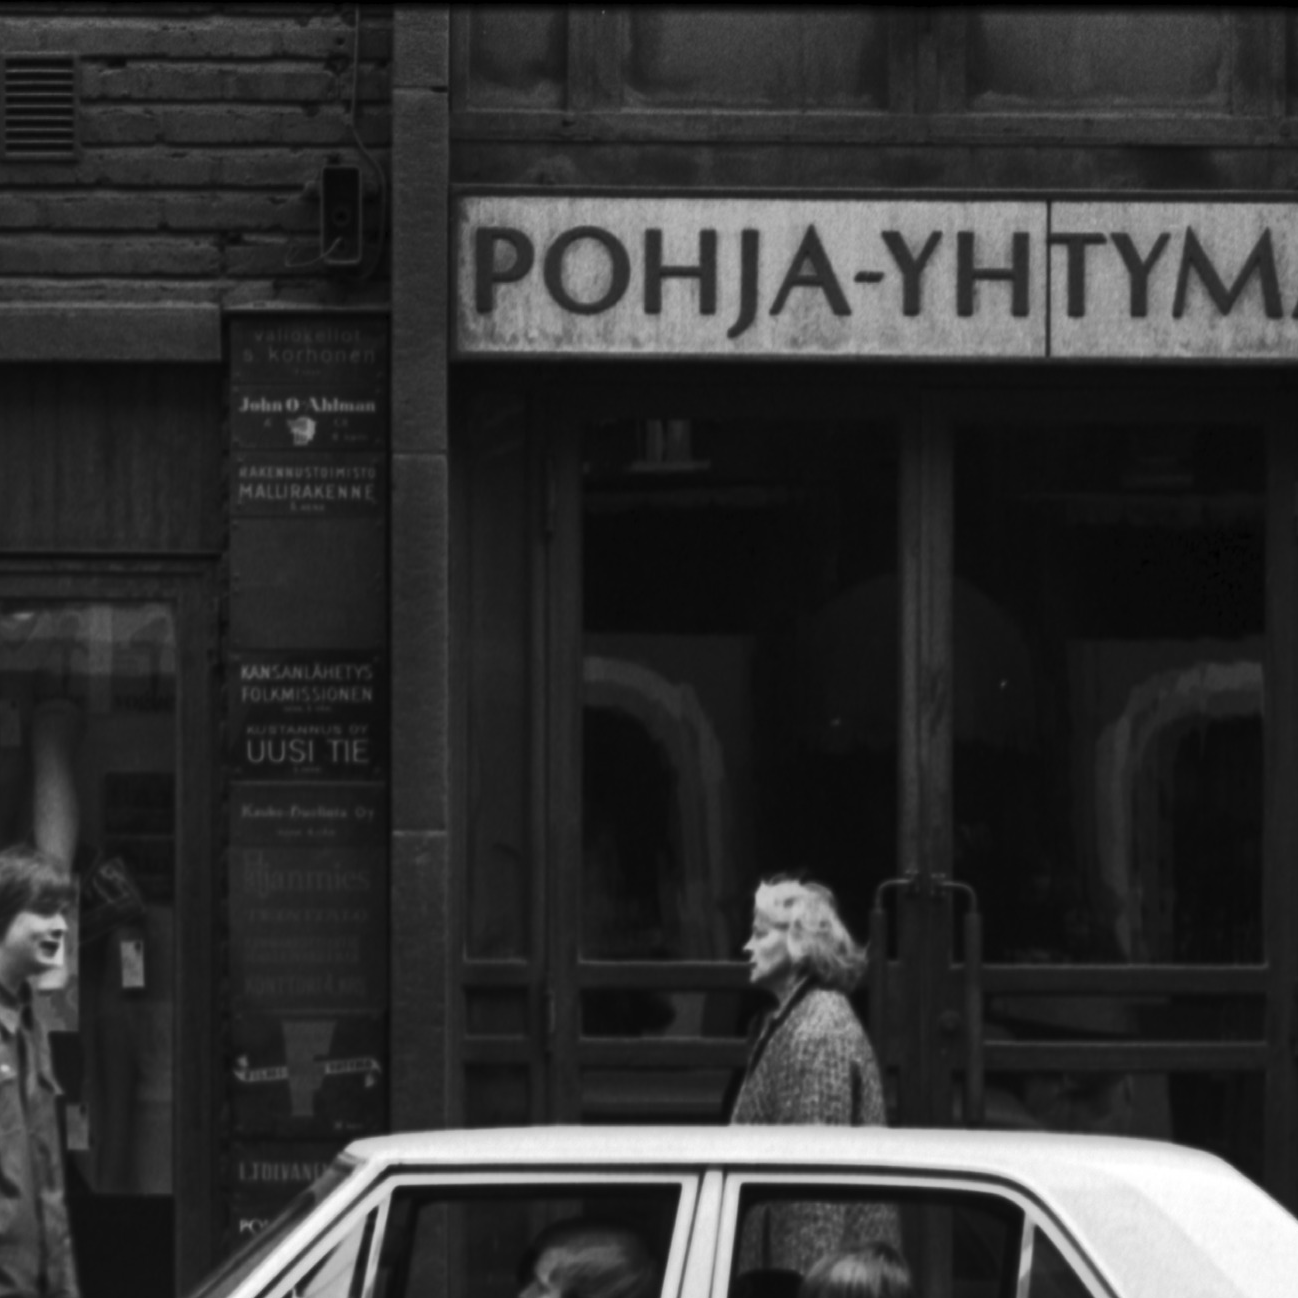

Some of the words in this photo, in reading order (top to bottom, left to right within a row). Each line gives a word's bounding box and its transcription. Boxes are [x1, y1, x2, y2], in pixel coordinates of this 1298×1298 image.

[238, 396, 283, 412] John
[239, 465, 376, 479] RAKENNUSTOIMISTO
[239, 483, 375, 500] MALLIRAKENNE
[240, 661, 373, 680] KANSANLÄHETYS
[241, 685, 373, 703] FOLKMISSIONEN
[246, 724, 343, 735] KUSTANNUS
[246, 739, 315, 763] UUSI
[327, 739, 370, 763] TIE
